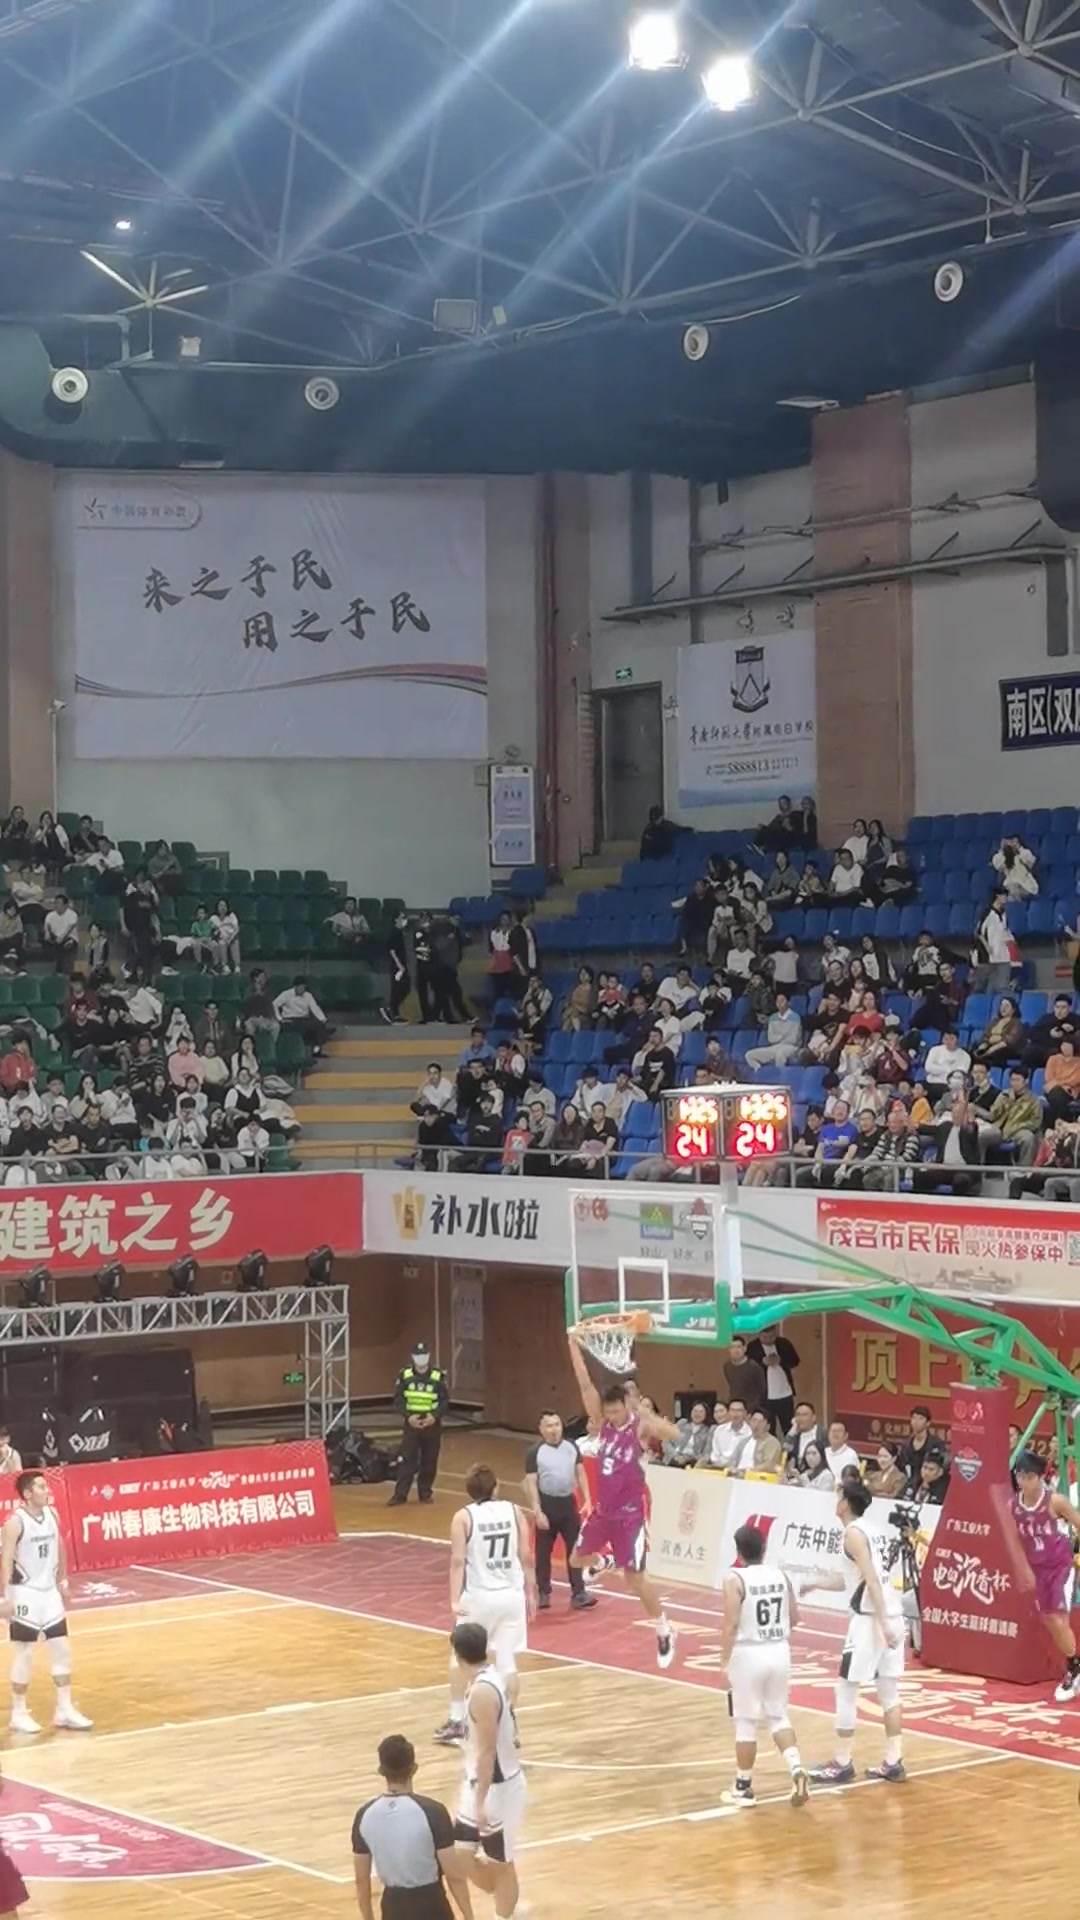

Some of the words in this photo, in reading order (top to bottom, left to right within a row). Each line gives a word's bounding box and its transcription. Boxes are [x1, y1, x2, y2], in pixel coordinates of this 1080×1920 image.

[142, 548, 333, 613] 来之于民
[242, 591, 432, 653] 用之于民
[676, 1123, 708, 1158] 24
[736, 1121, 775, 1157] 24
[0, 1188, 235, 1261] 建筑之乡
[430, 1193, 540, 1240] 补水啦
[827, 1217, 961, 1255] 茂名市民保
[82, 1490, 315, 1543] 广州春康生物科技有限公司
[483, 1533, 510, 1559] 77
[17, 1604, 28, 1617] 19
[756, 1597, 783, 1626] 67
